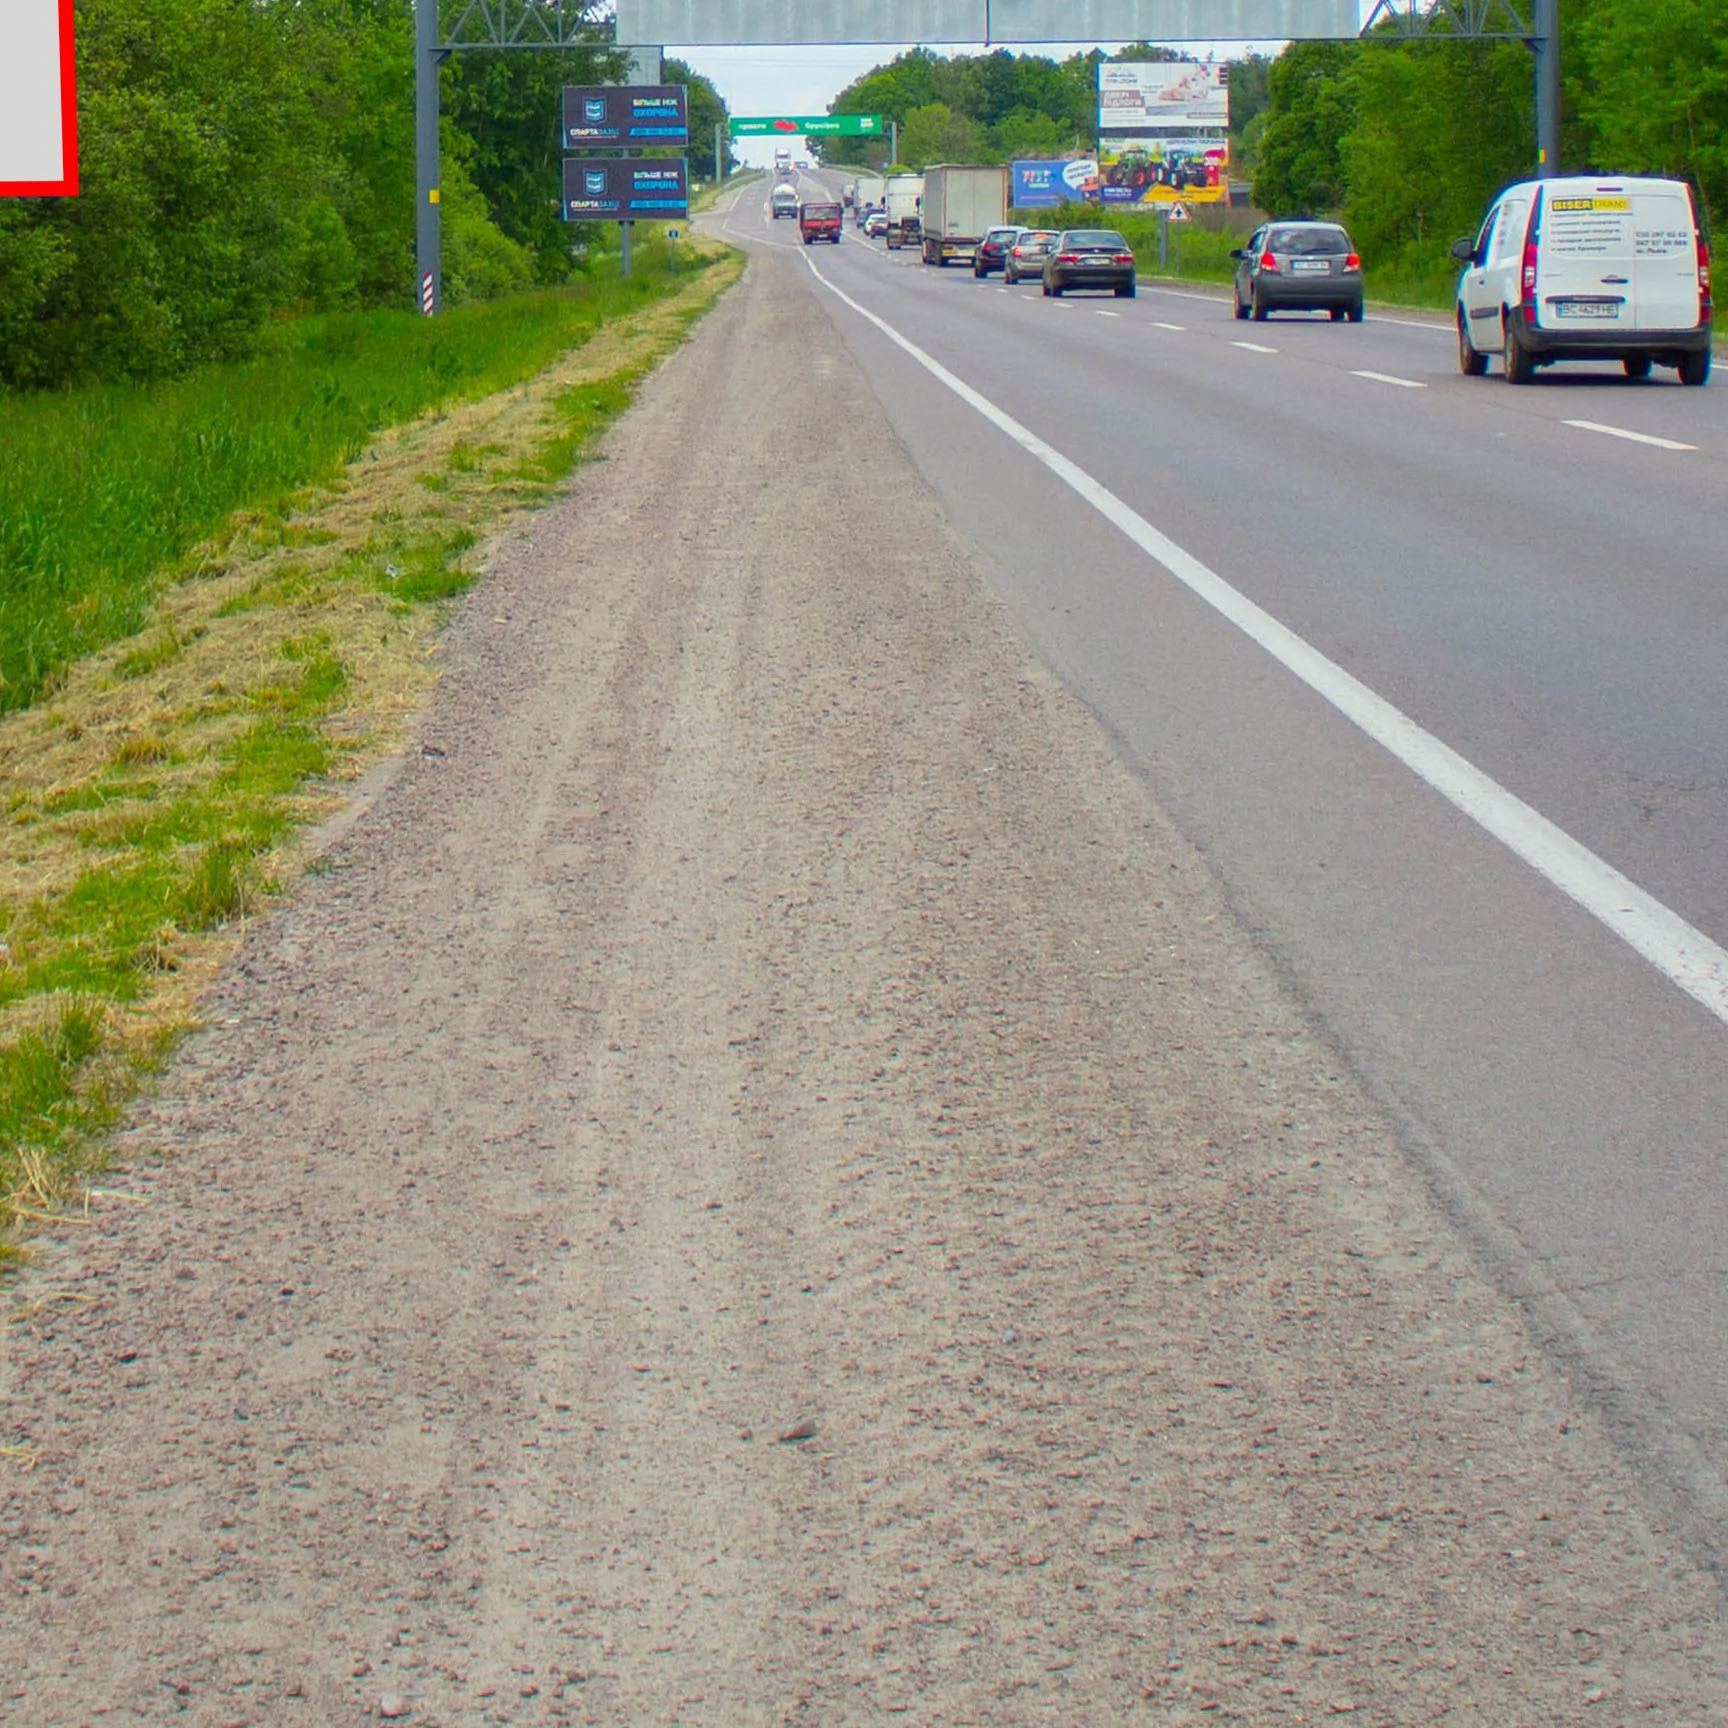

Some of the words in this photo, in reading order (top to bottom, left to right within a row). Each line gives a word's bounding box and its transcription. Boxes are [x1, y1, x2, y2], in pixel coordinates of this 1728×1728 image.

[633, 108, 678, 118] ОХОРОНА
[634, 180, 679, 190] ОХОРОНА
[1553, 200, 1592, 210] BISER
